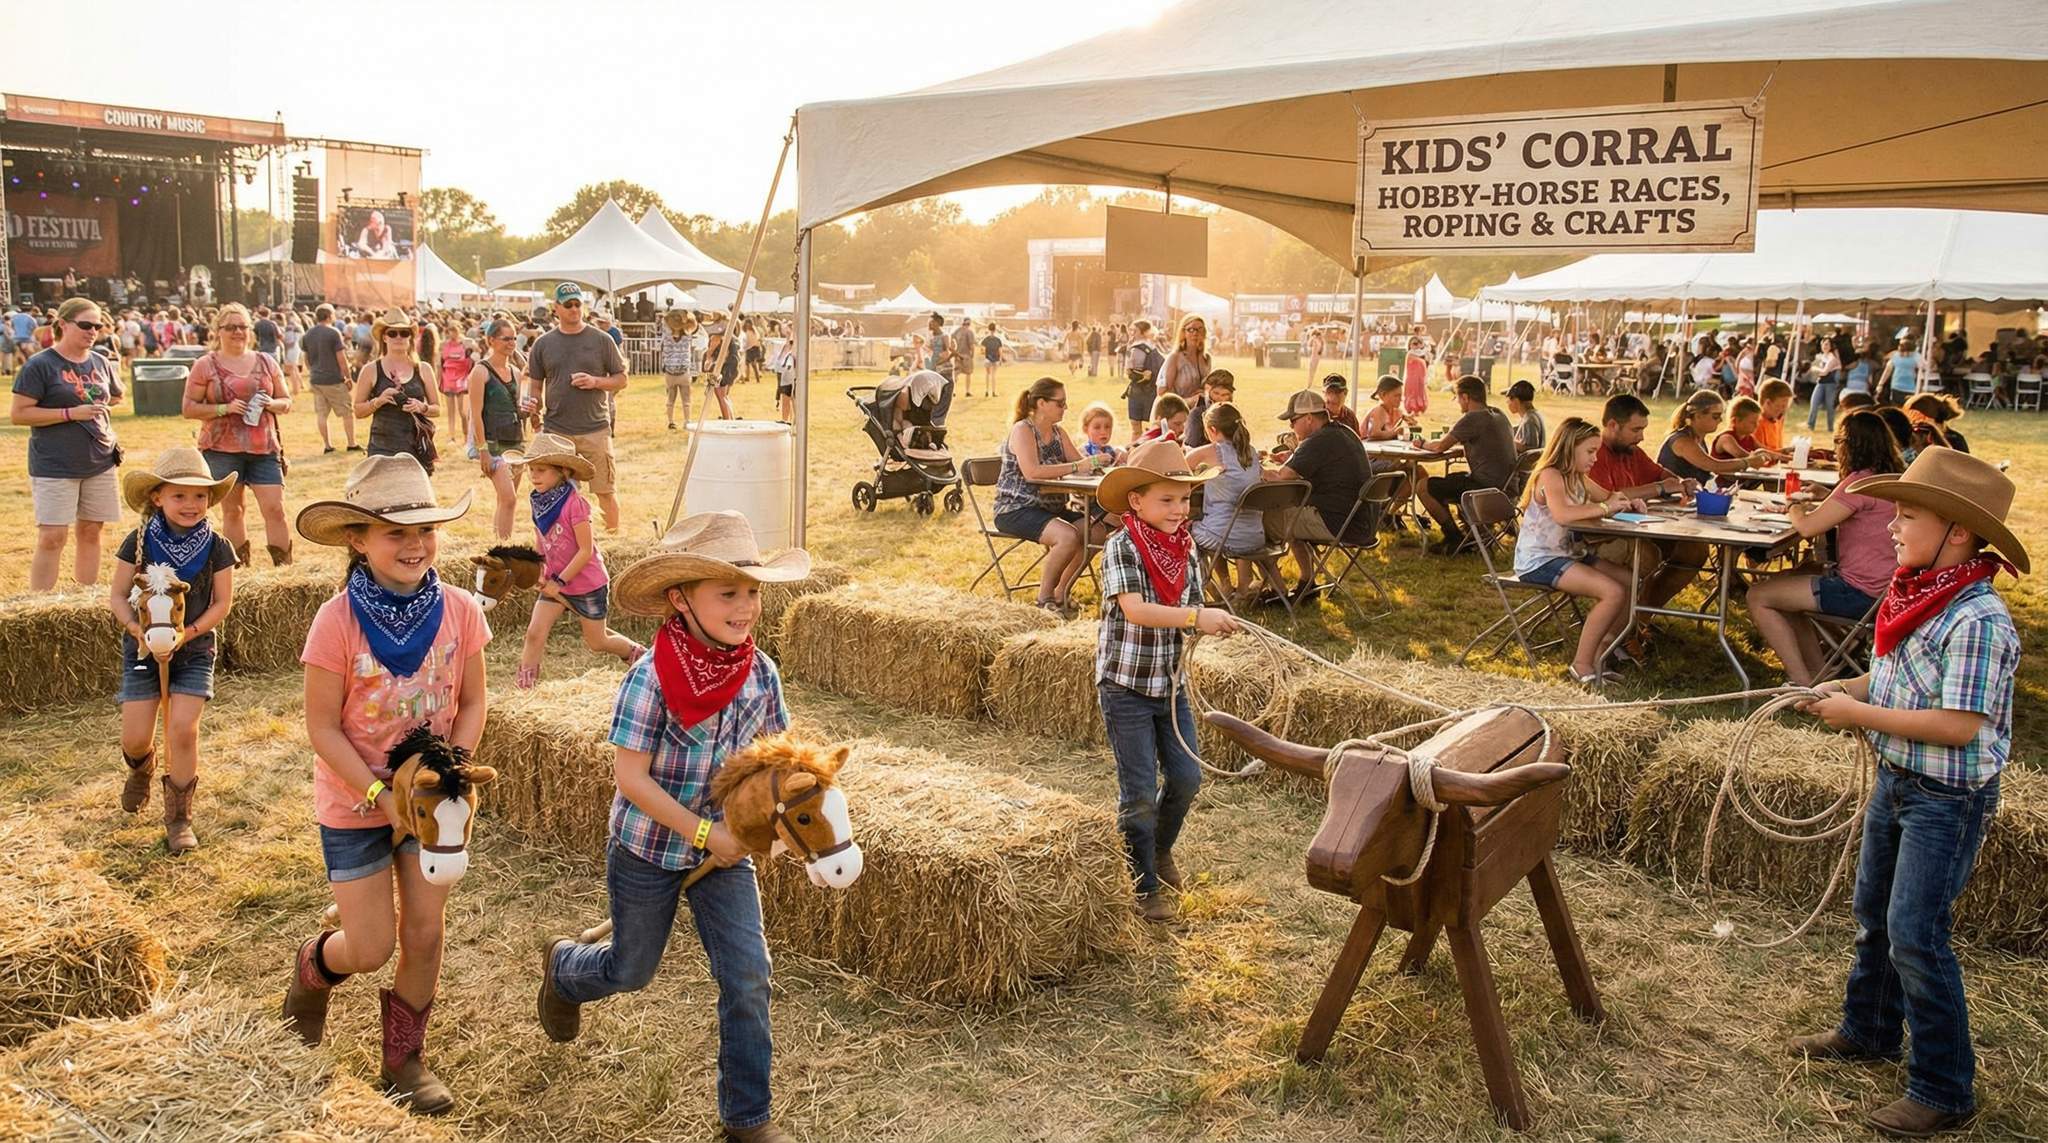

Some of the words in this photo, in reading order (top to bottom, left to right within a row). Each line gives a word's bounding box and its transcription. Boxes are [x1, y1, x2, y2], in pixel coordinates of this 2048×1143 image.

[103, 109, 163, 130] COUNTRY
[166, 115, 206, 134] MUSIC
[1381, 131, 1507, 176] KIDS’
[1522, 123, 1732, 170] CORRAL
[1377, 179, 1599, 210] HOBBY-HORSE
[1609, 175, 1730, 206] RACES,
[26, 215, 102, 240] FESTIVA
[1403, 212, 1522, 238] ROPING
[1530, 211, 1555, 236] &
[1564, 208, 1696, 235] CRAFTS
